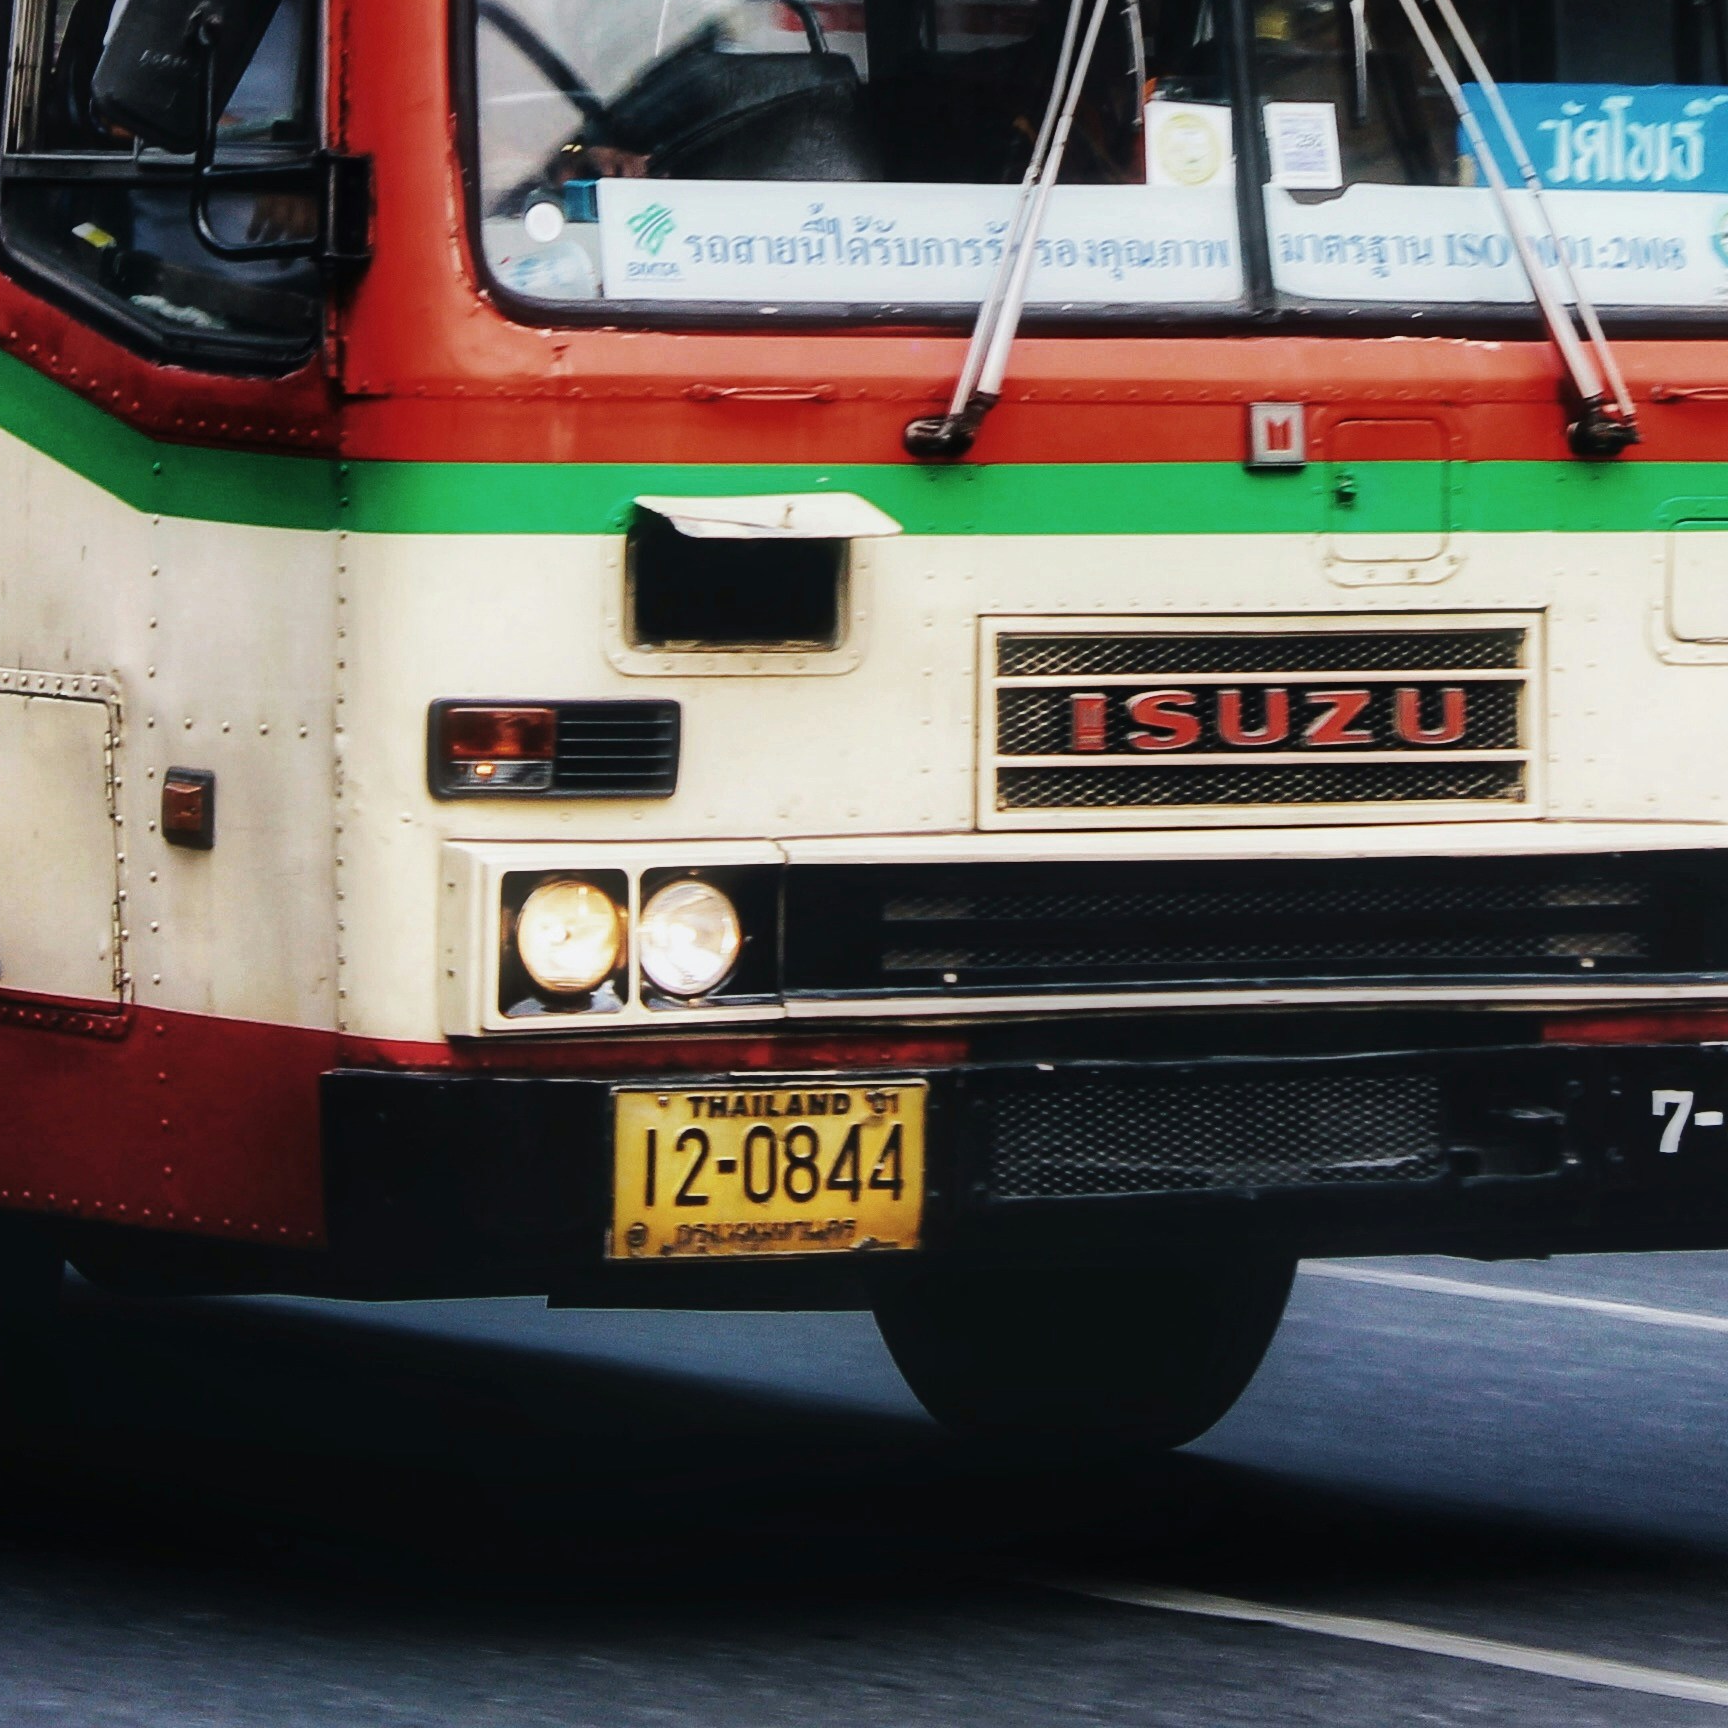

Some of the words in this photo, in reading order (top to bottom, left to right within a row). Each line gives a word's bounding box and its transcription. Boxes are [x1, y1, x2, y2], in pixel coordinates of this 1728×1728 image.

[682, 202, 1233, 282] รถสายนี้ได้รับการรัรองคุณภาพ
[1445, 232, 1514, 268] ISO
[1071, 687, 1469, 752] ISUZU
[685, 1092, 852, 1119] THAILAND
[644, 1122, 905, 1209] 12-0844
